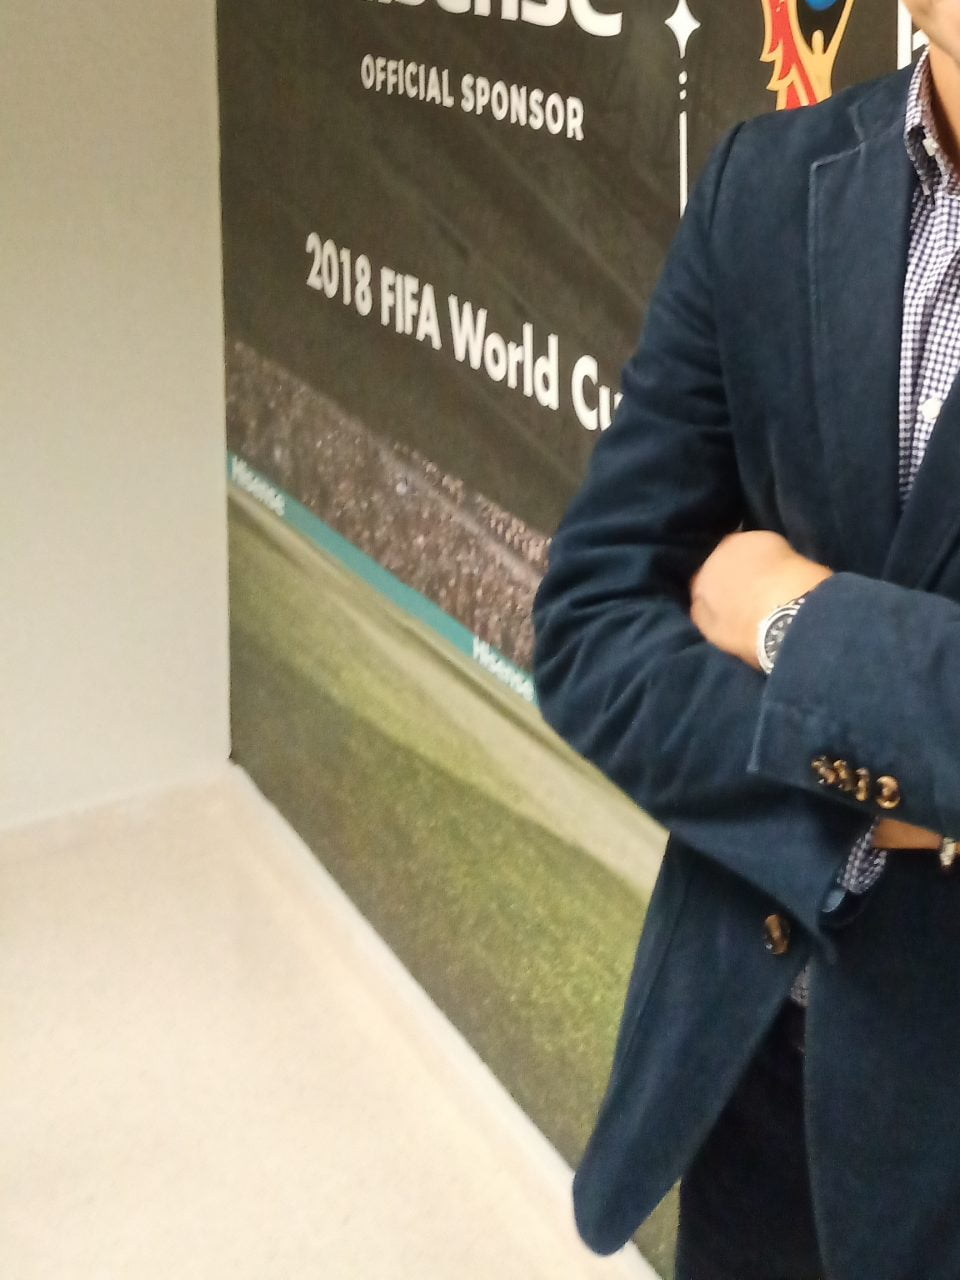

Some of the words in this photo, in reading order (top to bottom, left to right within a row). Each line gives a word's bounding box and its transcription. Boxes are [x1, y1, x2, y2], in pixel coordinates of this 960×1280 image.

[360, 53, 455, 108] OFFICIAL
[460, 73, 585, 142] SPONSOR
[305, 232, 373, 317] 2018
[380, 266, 442, 351] FIFA
[447, 293, 560, 411] World
